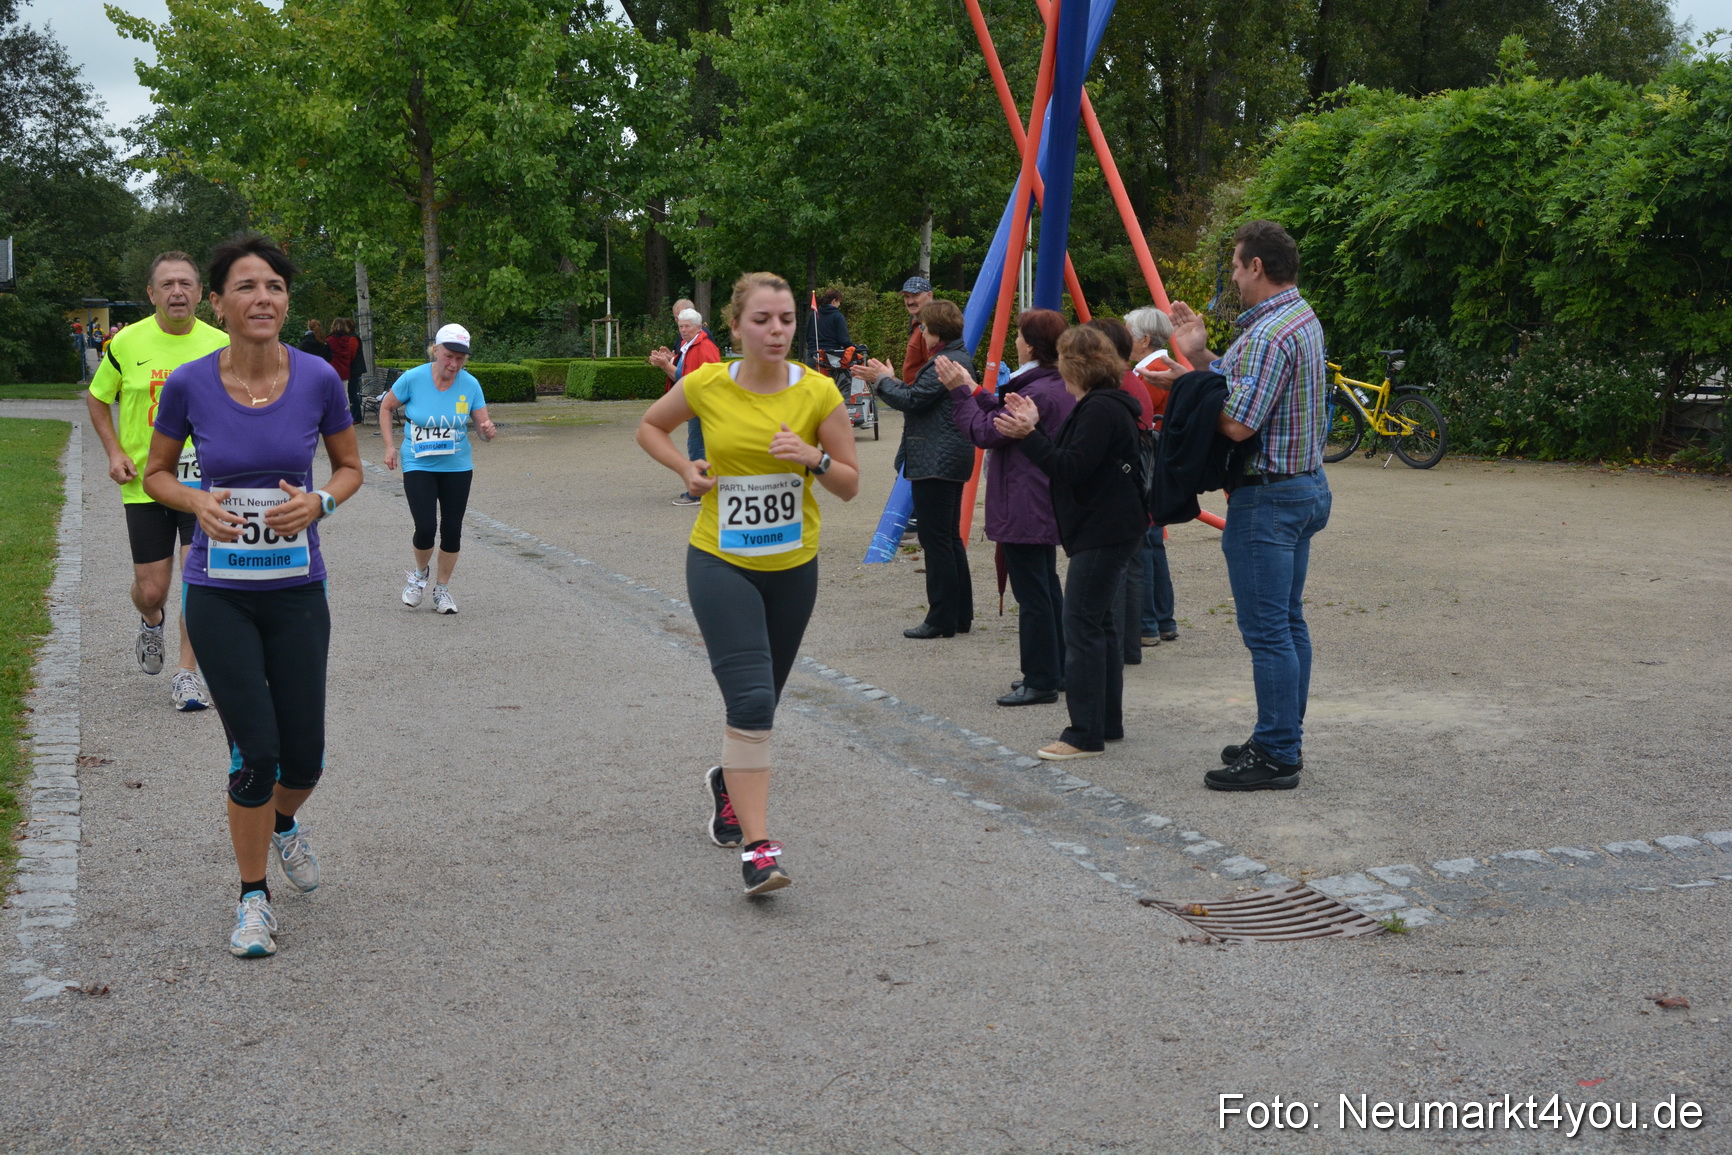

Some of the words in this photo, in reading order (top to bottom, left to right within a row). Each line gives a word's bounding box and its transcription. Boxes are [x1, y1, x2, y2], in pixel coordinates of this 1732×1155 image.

[151, 369, 173, 379] Mü
[425, 415, 468, 428] ANY
[414, 426, 451, 441] 2142
[177, 460, 202, 478] 73
[719, 484, 746, 492] PARTL
[747, 480, 788, 491] Neumarkt
[219, 497, 245, 507] ARTL
[727, 491, 795, 525] 2589
[741, 532, 784, 545] Yvonne
[228, 552, 292, 567] Germaine
